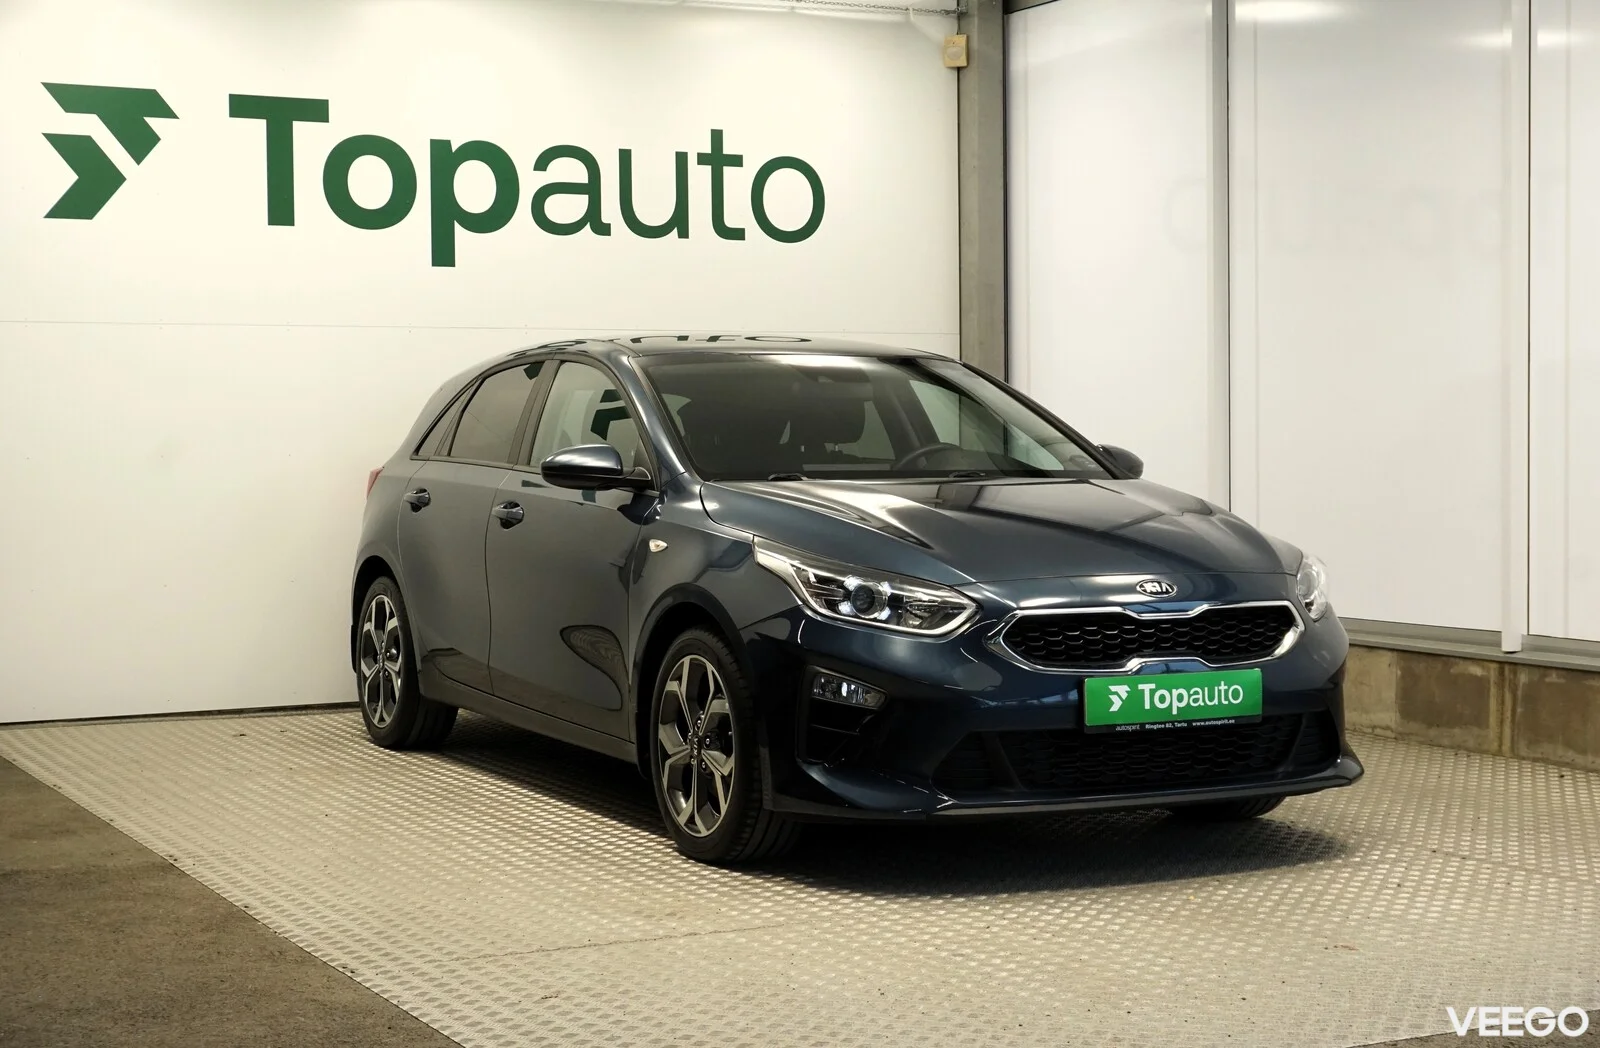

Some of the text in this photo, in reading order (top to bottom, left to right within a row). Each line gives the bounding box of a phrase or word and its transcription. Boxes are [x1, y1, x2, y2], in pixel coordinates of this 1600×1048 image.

[228, 93, 827, 268] Topauto
[1141, 581, 1173, 593] KIA
[1137, 680, 1244, 715] Topauto
